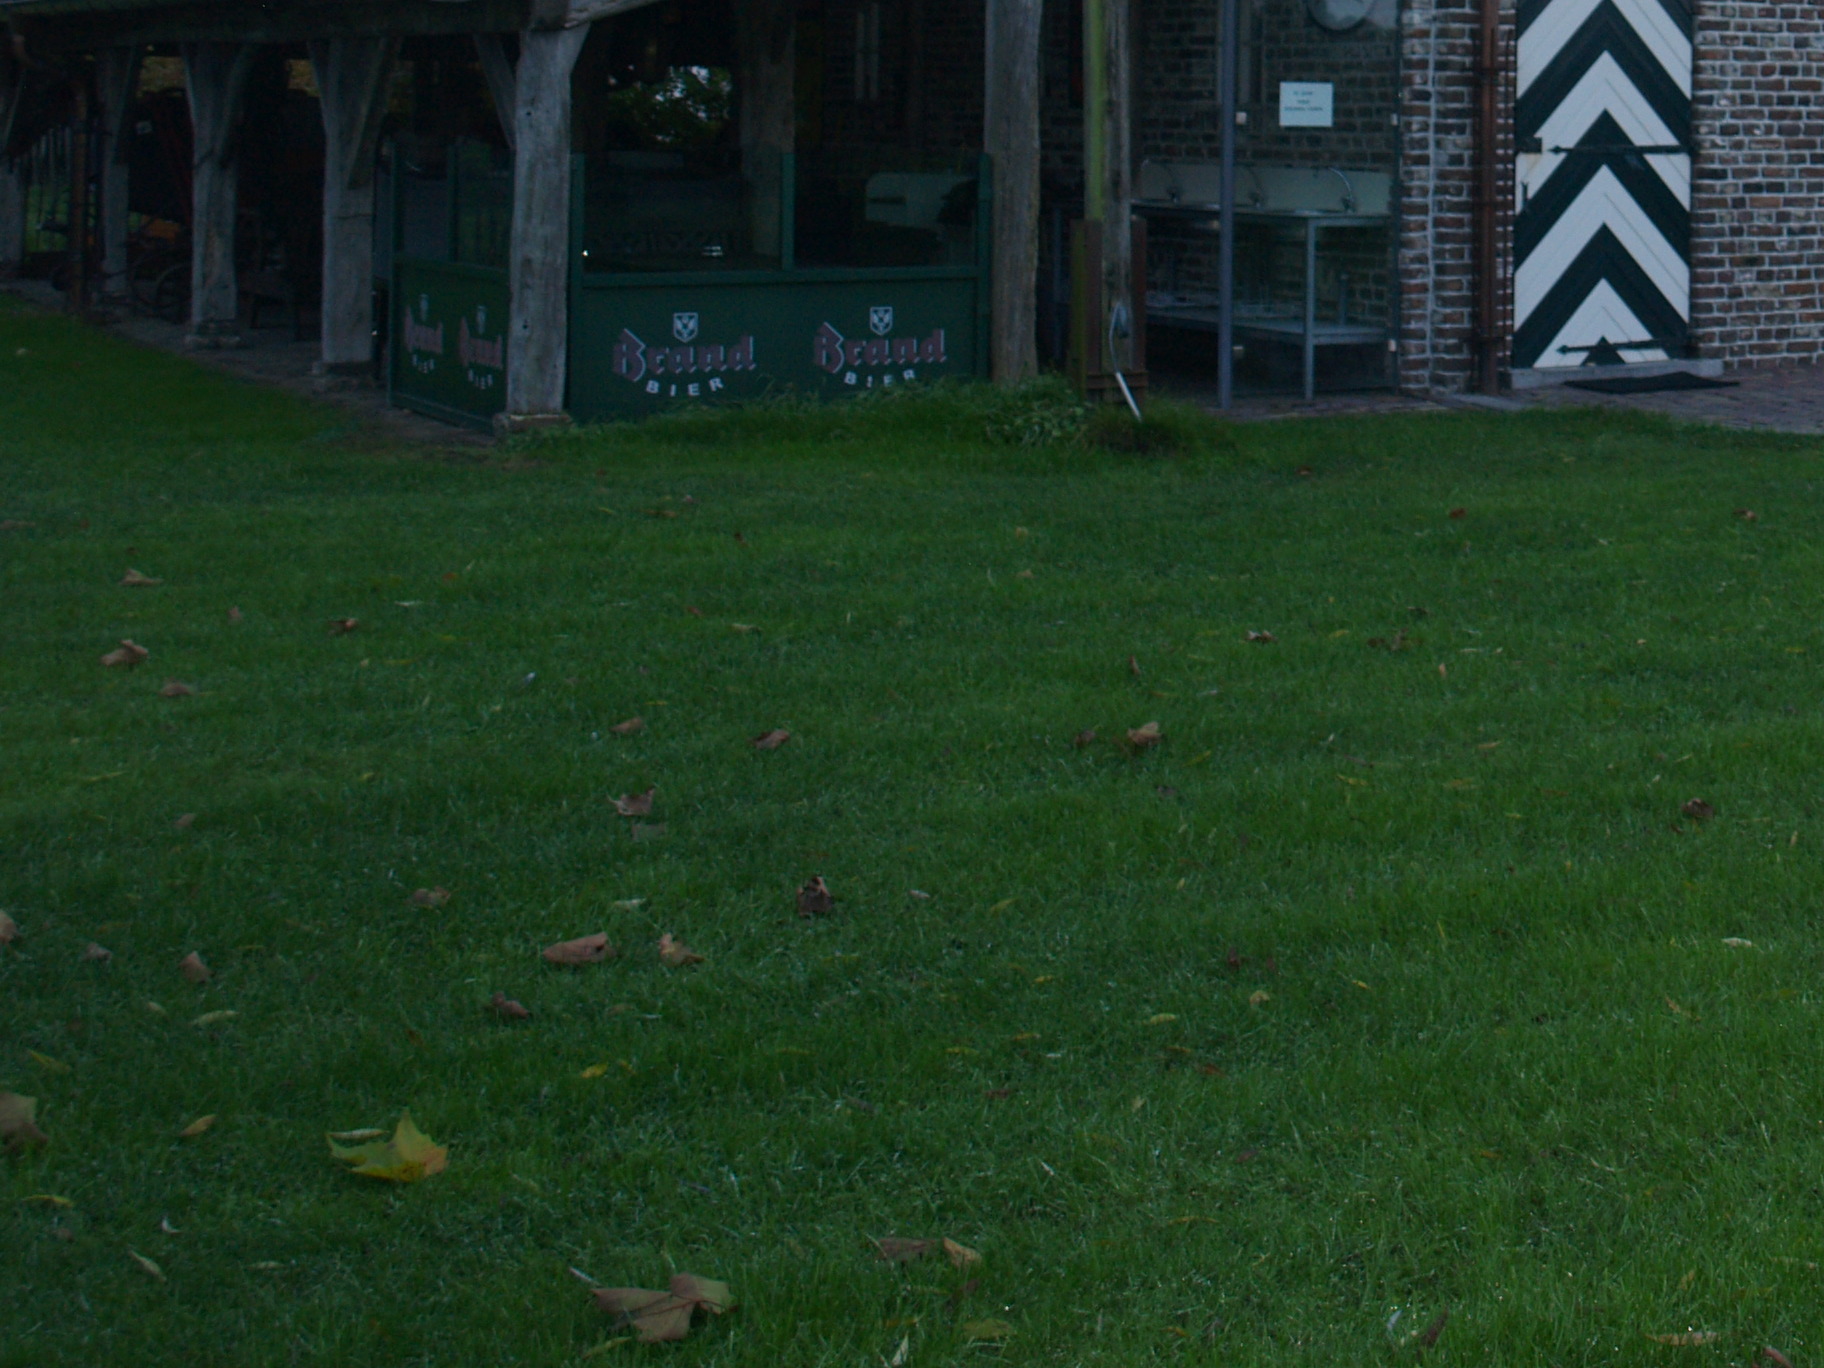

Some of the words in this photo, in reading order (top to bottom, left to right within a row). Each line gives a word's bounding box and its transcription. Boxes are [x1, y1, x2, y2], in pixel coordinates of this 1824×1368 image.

[611, 327, 757, 383] Brand
[814, 321, 947, 374] Brand
[645, 376, 725, 397] BIER
[842, 368, 916, 389] BIER
